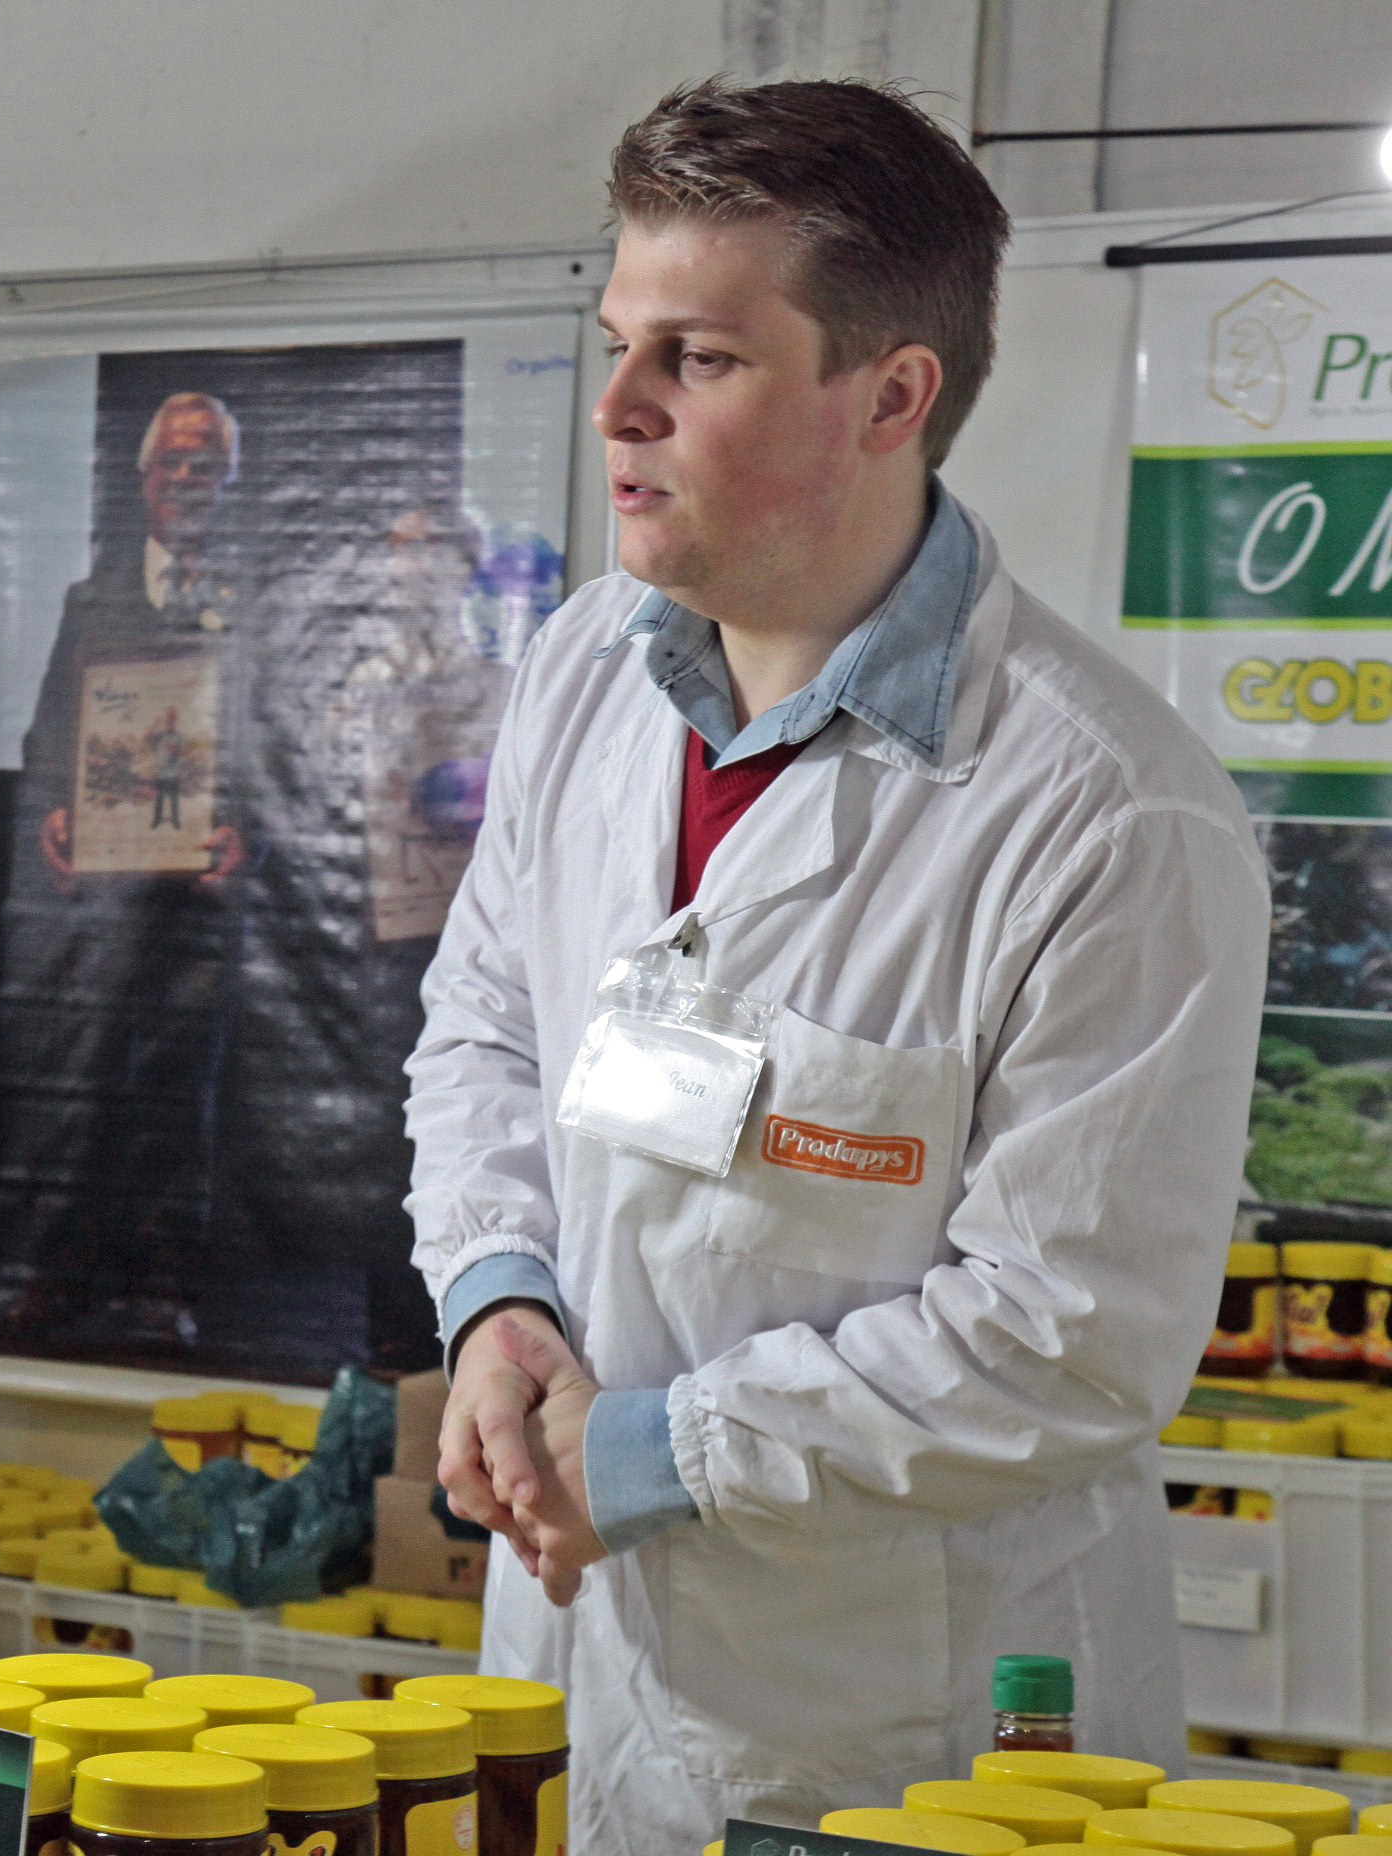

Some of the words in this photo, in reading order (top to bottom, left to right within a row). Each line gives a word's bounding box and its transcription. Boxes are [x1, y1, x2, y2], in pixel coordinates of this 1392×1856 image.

[1313, 333, 1392, 401] Pr
[1237, 481, 1327, 596] O
[778, 1125, 906, 1172] Prodapys
